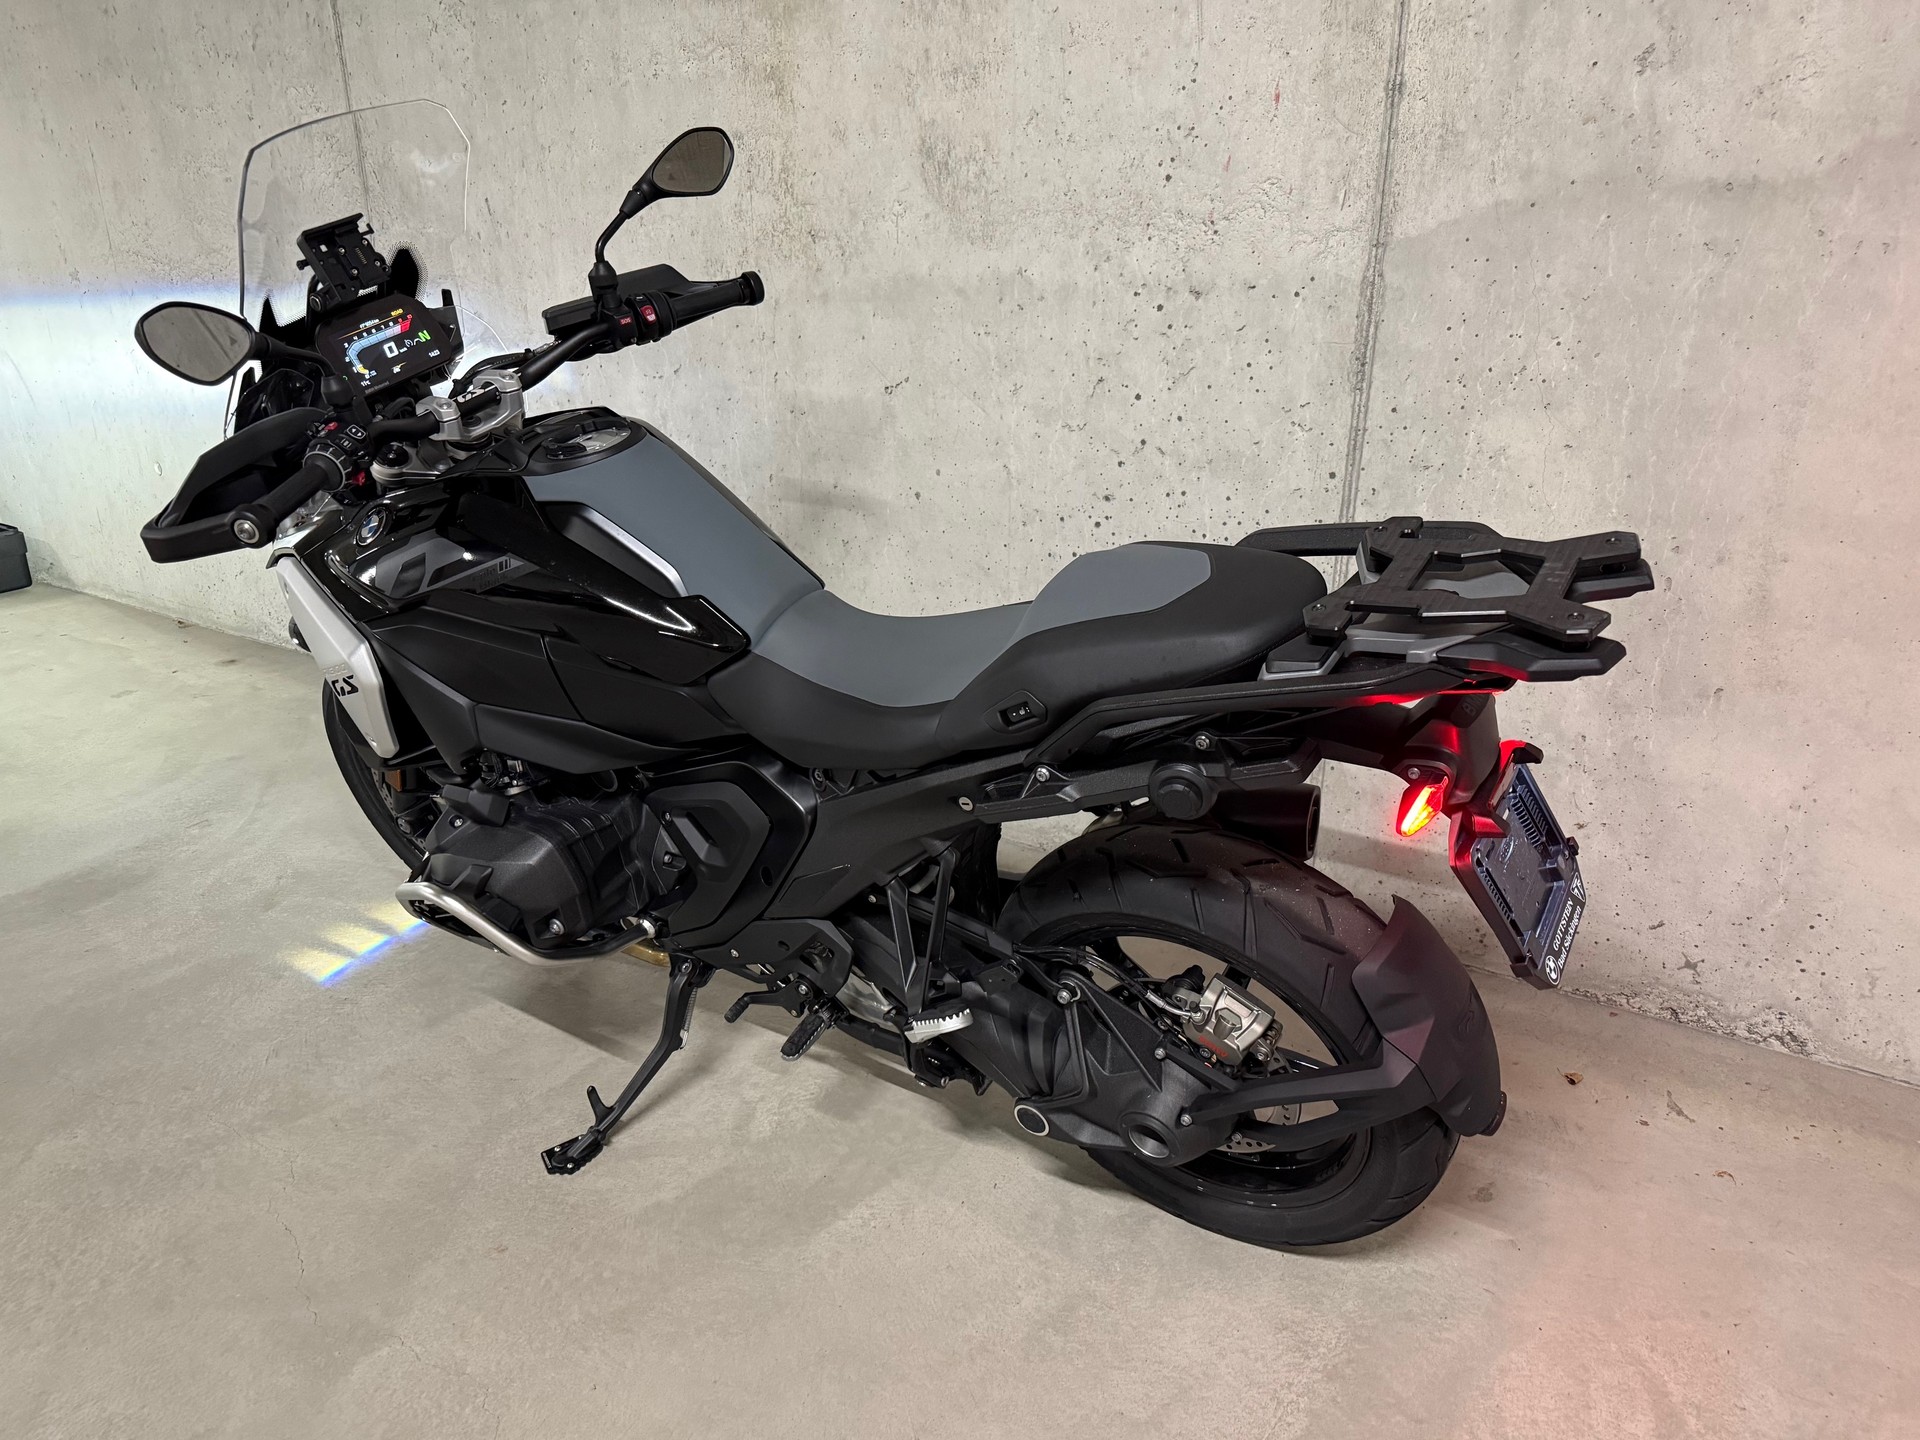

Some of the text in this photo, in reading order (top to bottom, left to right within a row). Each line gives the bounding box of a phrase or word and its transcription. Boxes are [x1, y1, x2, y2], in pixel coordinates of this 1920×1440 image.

[418, 330, 431, 342] N
[383, 341, 399, 358] 0
[331, 674, 359, 697] GS
[1553, 897, 1574, 951] GOTTSTEIN
[1558, 905, 1582, 970] Bad Säckingen
